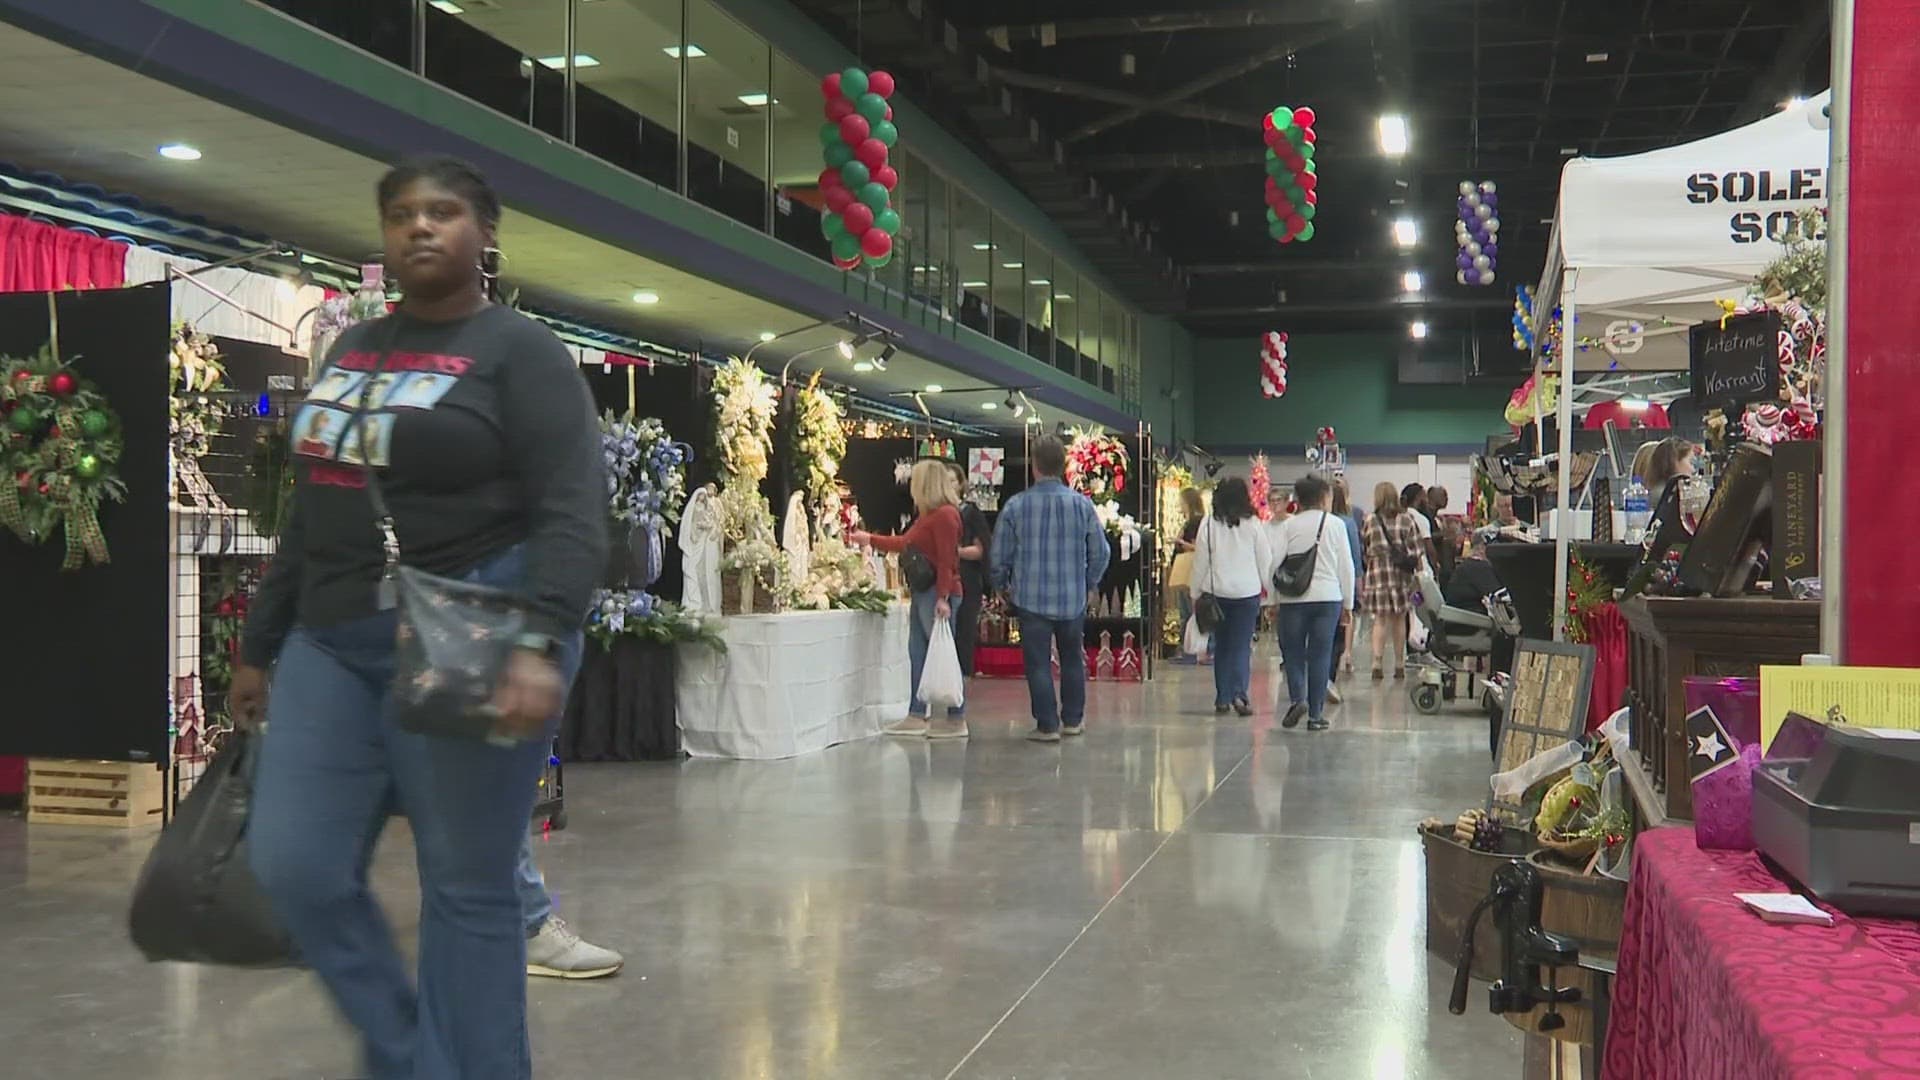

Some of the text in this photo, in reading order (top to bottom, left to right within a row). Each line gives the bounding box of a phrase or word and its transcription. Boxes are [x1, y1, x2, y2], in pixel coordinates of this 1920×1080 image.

[1687, 168, 1830, 204] SOLE
[1730, 211, 1827, 243] SO
[1705, 356, 1766, 395] Warranty
[1786, 472, 1797, 547] VINEYARD
